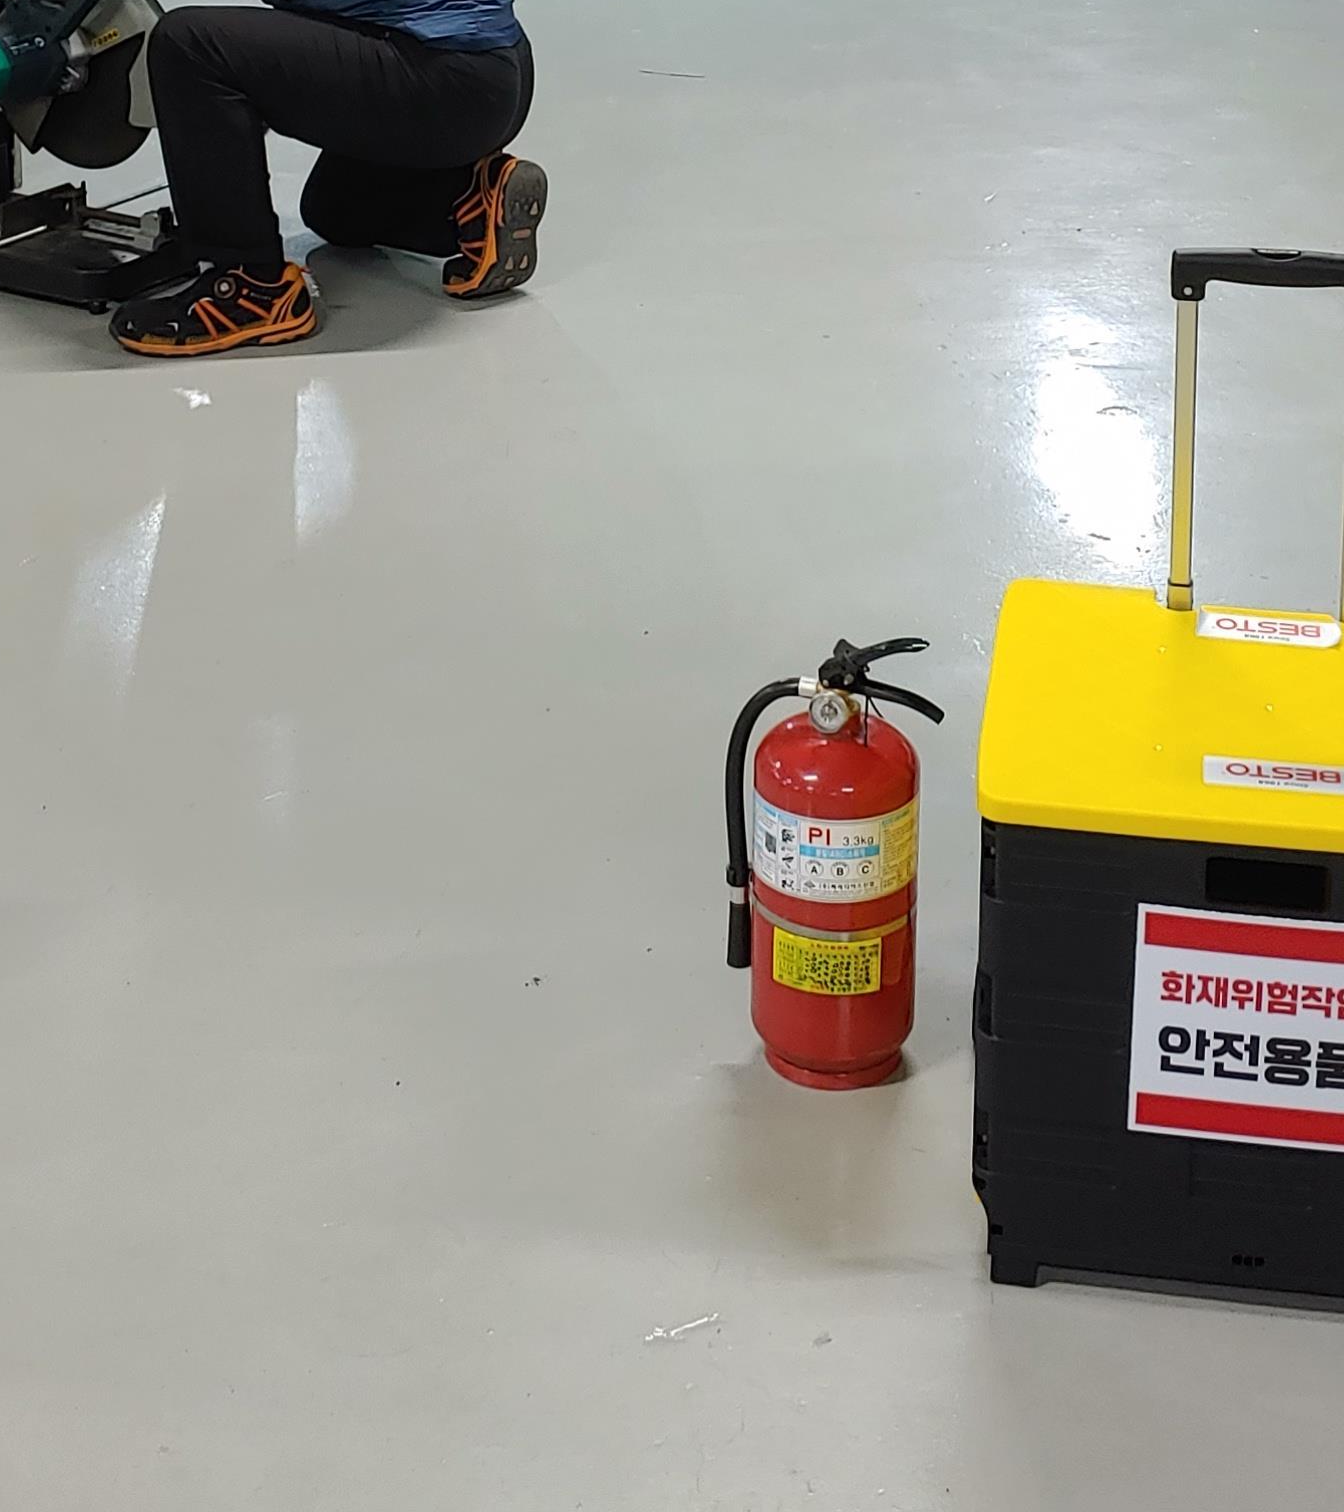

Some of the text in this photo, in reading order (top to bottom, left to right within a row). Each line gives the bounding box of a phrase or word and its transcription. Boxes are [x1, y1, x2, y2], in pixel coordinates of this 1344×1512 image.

[1216, 618, 1321, 638] BESTO
[1225, 763, 1342, 784] BESTO
[842, 836, 874, 847] 3.3kg
[810, 866, 870, 875] A B C
